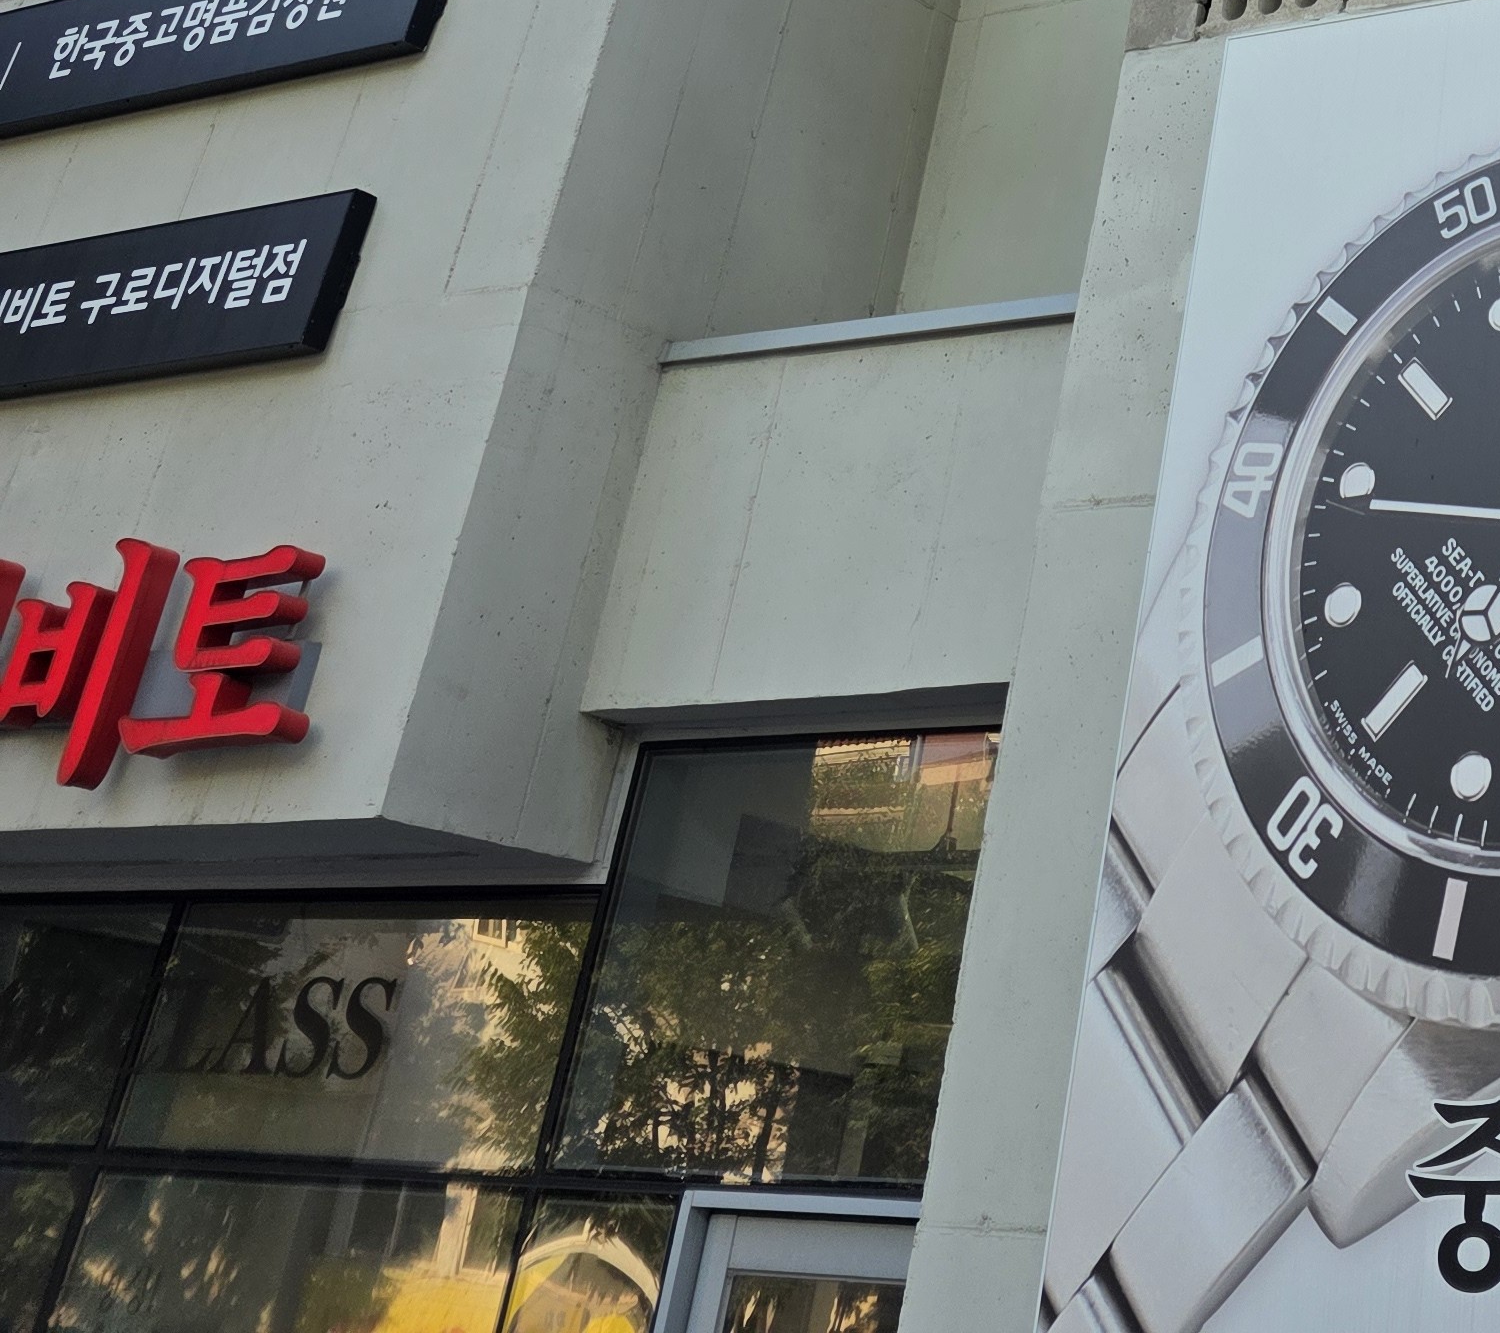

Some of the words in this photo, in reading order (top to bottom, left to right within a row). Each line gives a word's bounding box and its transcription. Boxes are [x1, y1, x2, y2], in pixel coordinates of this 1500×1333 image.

[1434, 175, 1497, 240] 50
[0, 279, 76, 335] 비토
[80, 238, 308, 325] 구로디지털점
[1222, 442, 1284, 518] 40
[1390, 547, 1455, 628] SUPERLATIVE
[1392, 582, 1446, 647] OFFICIALLY
[0, 537, 326, 791] 비토
[1330, 699, 1358, 745] SWISS
[1358, 745, 1393, 786] MADE
[1267, 776, 1344, 879] 30
